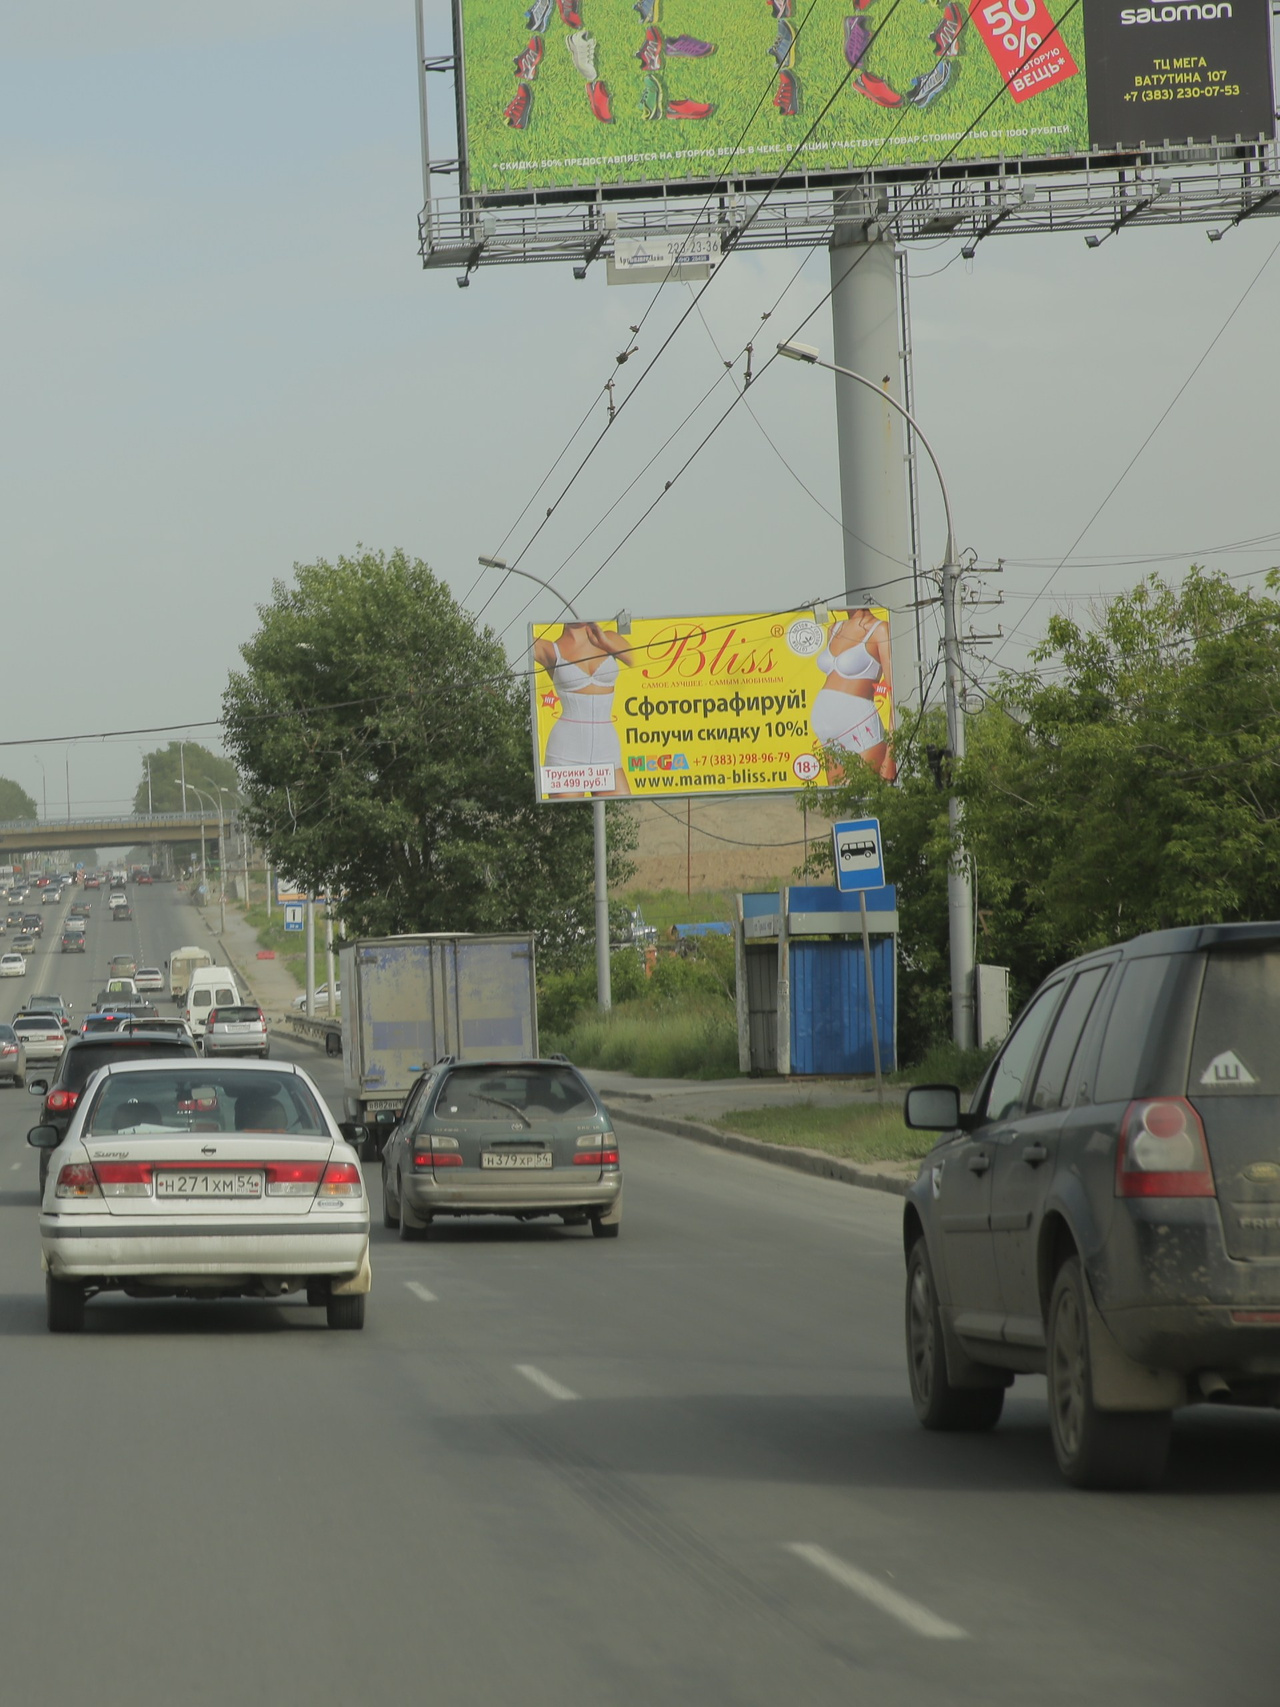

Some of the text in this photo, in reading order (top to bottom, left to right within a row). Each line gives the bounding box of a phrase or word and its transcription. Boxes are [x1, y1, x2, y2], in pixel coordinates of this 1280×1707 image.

[982, 0, 1036, 35] 50
[1120, 2, 1233, 25] salomon
[1023, 47, 1060, 70] ВТОРУЮ
[1153, 57, 1207, 71] ТЦ МЕГА
[1134, 70, 1227, 87] ВАТУТИНА 107
[1123, 85, 1240, 102] +7 (383) 230-07-53
[541, 158, 562, 168] 50%
[564, 152, 657, 167] ПРЕДОСТАВЛЯЕТСЯ
[659, 151, 673, 160] НА
[675, 148, 715, 159] ВТОРУЮ
[717, 146, 745, 156] ВЕЩЬ
[748, 146, 755, 154] В
[786, 143, 793, 151] В
[831, 137, 886, 150] УЧАСТВУЕТ
[888, 134, 920, 146] ТОВАР
[991, 129, 1003, 138] ОТ
[1006, 127, 1028, 138] 1000
[642, 623, 778, 680] Bliss
[708, 679, 739, 687] САМЫМ
[741, 676, 784, 686] ЛЮБИМЫМ
[624, 689, 807, 719] Сфотографируй!
[626, 720, 808, 747] Получи скидку 10%!
[693, 752, 790, 767] +7 (383) 298-96-79
[796, 761, 818, 773] 18+
[545, 768, 611, 779] Трусики 3 шт.
[634, 770, 787, 788] www.mama-bliss.ru
[564, 779, 580, 787] 499
[93, 1151, 129, 1160] Sunny
[486, 1152, 549, 1166] Н379ХР 54
[165, 1175, 255, 1193] Н271ХМ 54
